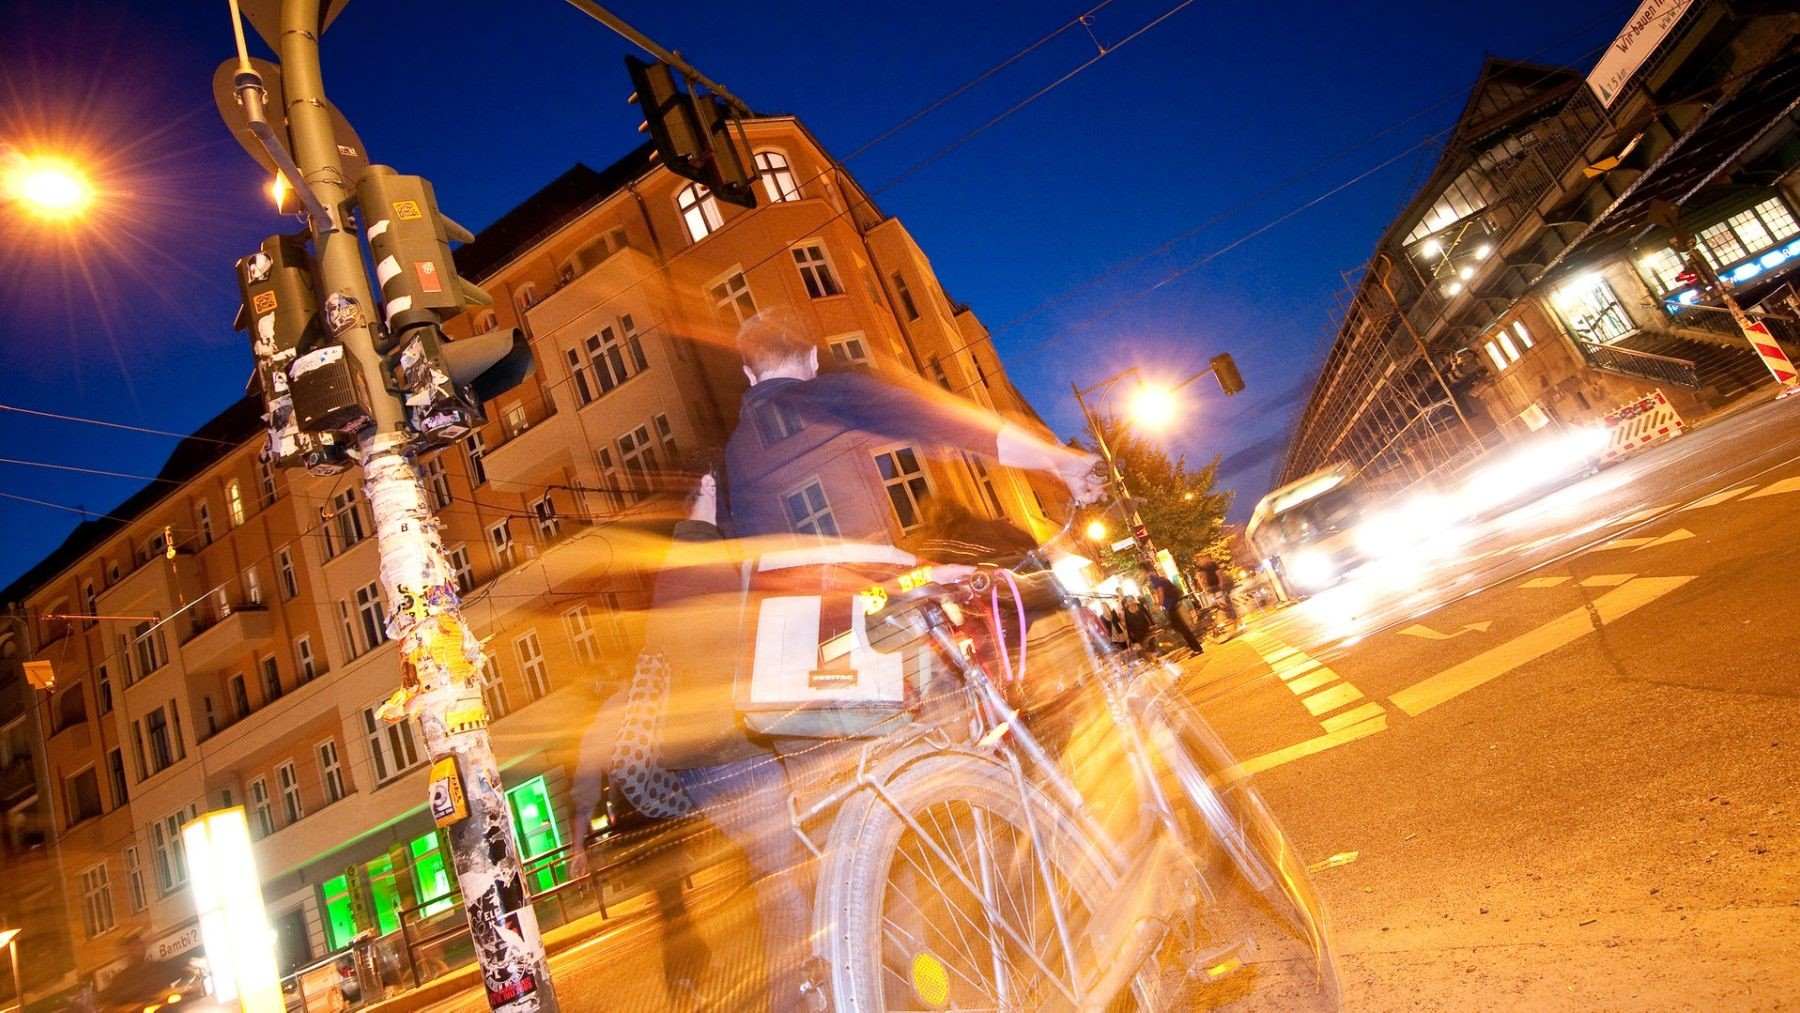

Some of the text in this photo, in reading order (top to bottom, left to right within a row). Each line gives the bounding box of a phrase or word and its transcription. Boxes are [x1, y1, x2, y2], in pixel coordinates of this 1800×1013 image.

[1616, 34, 1634, 54] Wir
[1631, 6, 1657, 36] bauen
[159, 929, 198, 957] Bambi?
